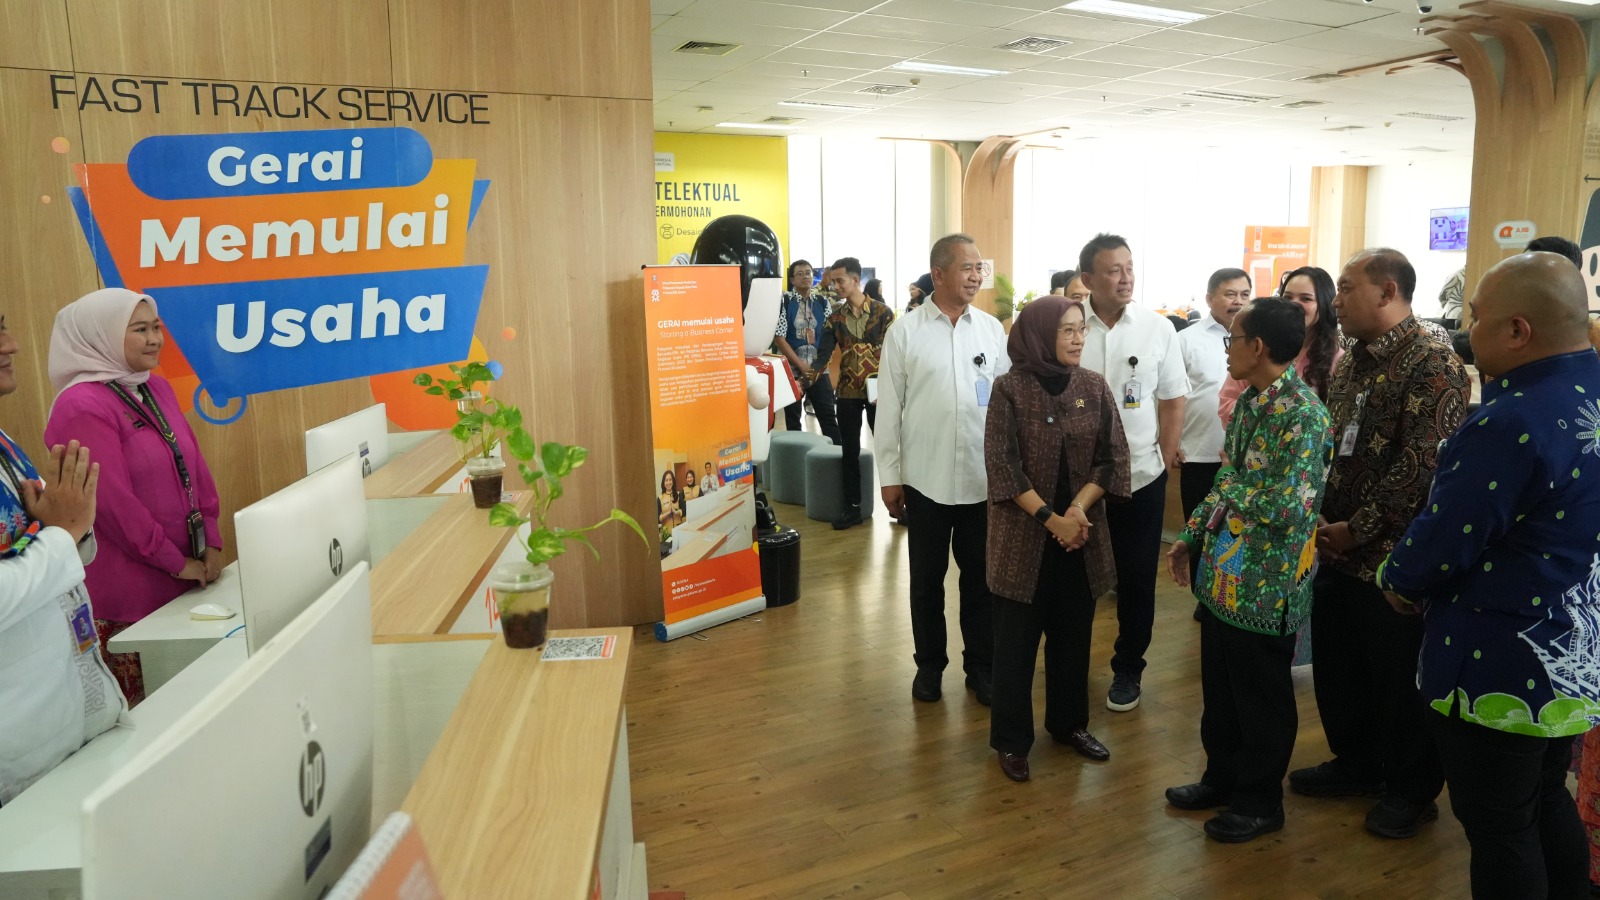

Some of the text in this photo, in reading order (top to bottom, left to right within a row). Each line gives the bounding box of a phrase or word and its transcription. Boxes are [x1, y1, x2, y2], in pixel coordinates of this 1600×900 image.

[49, 75, 491, 125] FAST TRACK SERVICE
[207, 136, 364, 187] Gerai
[655, 182, 741, 201] TELEKTUAL
[139, 193, 450, 268] Memulai
[215, 287, 447, 354] Usaha
[682, 317, 713, 326] memulai
[714, 316, 735, 324] usaha
